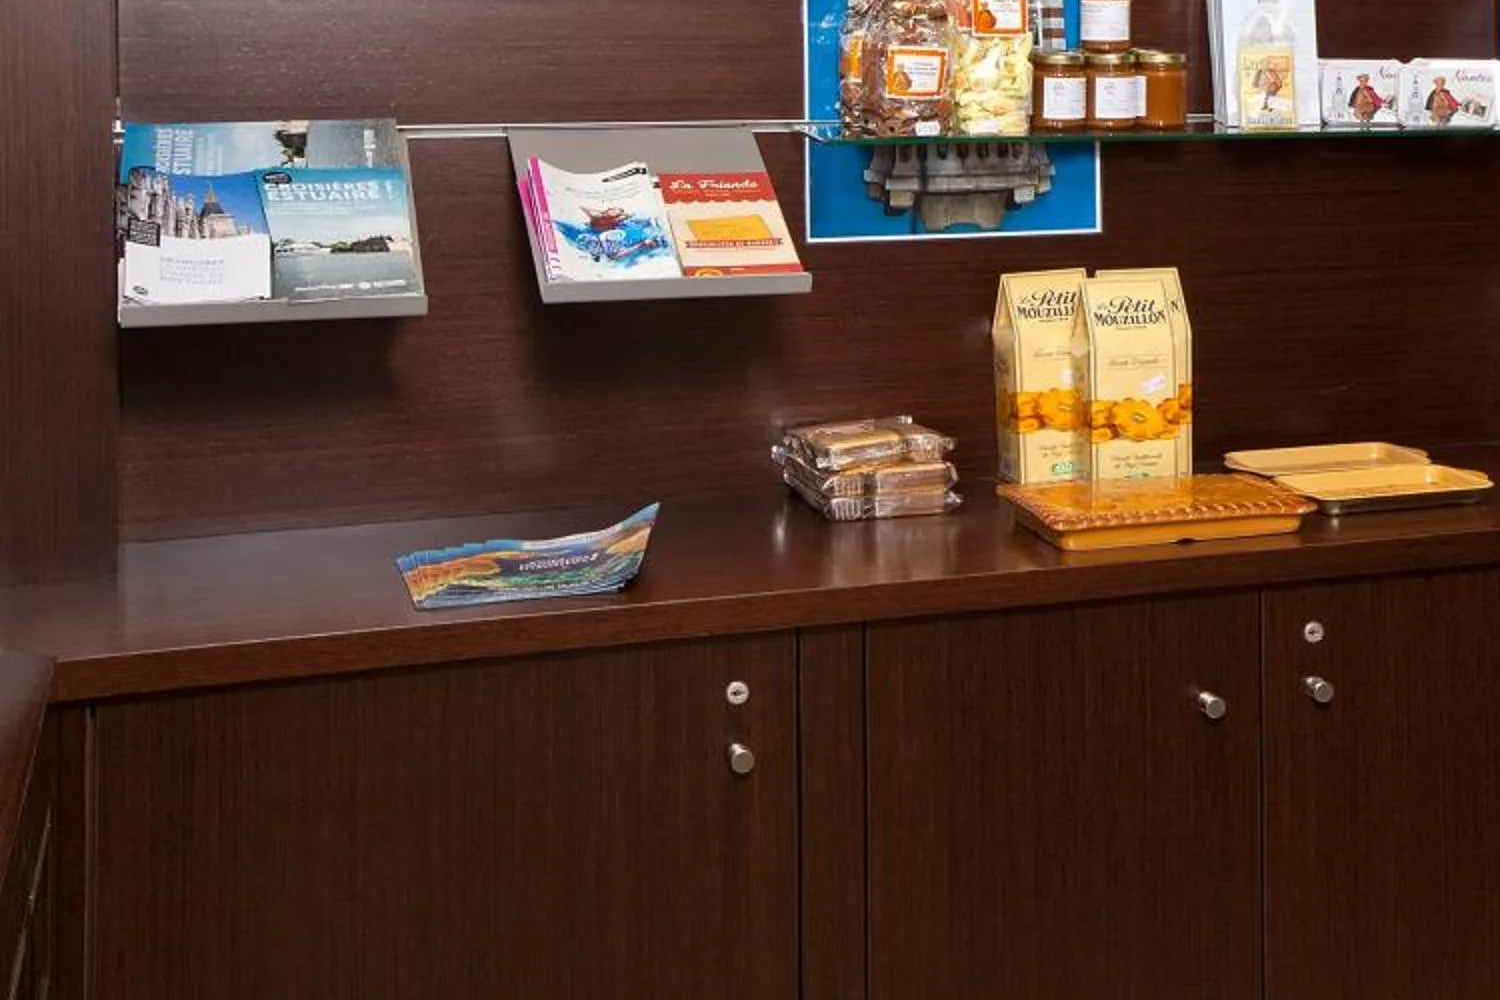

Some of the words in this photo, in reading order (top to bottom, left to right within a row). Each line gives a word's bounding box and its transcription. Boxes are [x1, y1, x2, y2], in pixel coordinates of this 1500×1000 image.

[1454, 67, 1494, 84] Nantes
[1031, 289, 1077, 306] Petit
[1107, 296, 1156, 315] Petit
[1093, 309, 1167, 328] MOUZILLON
